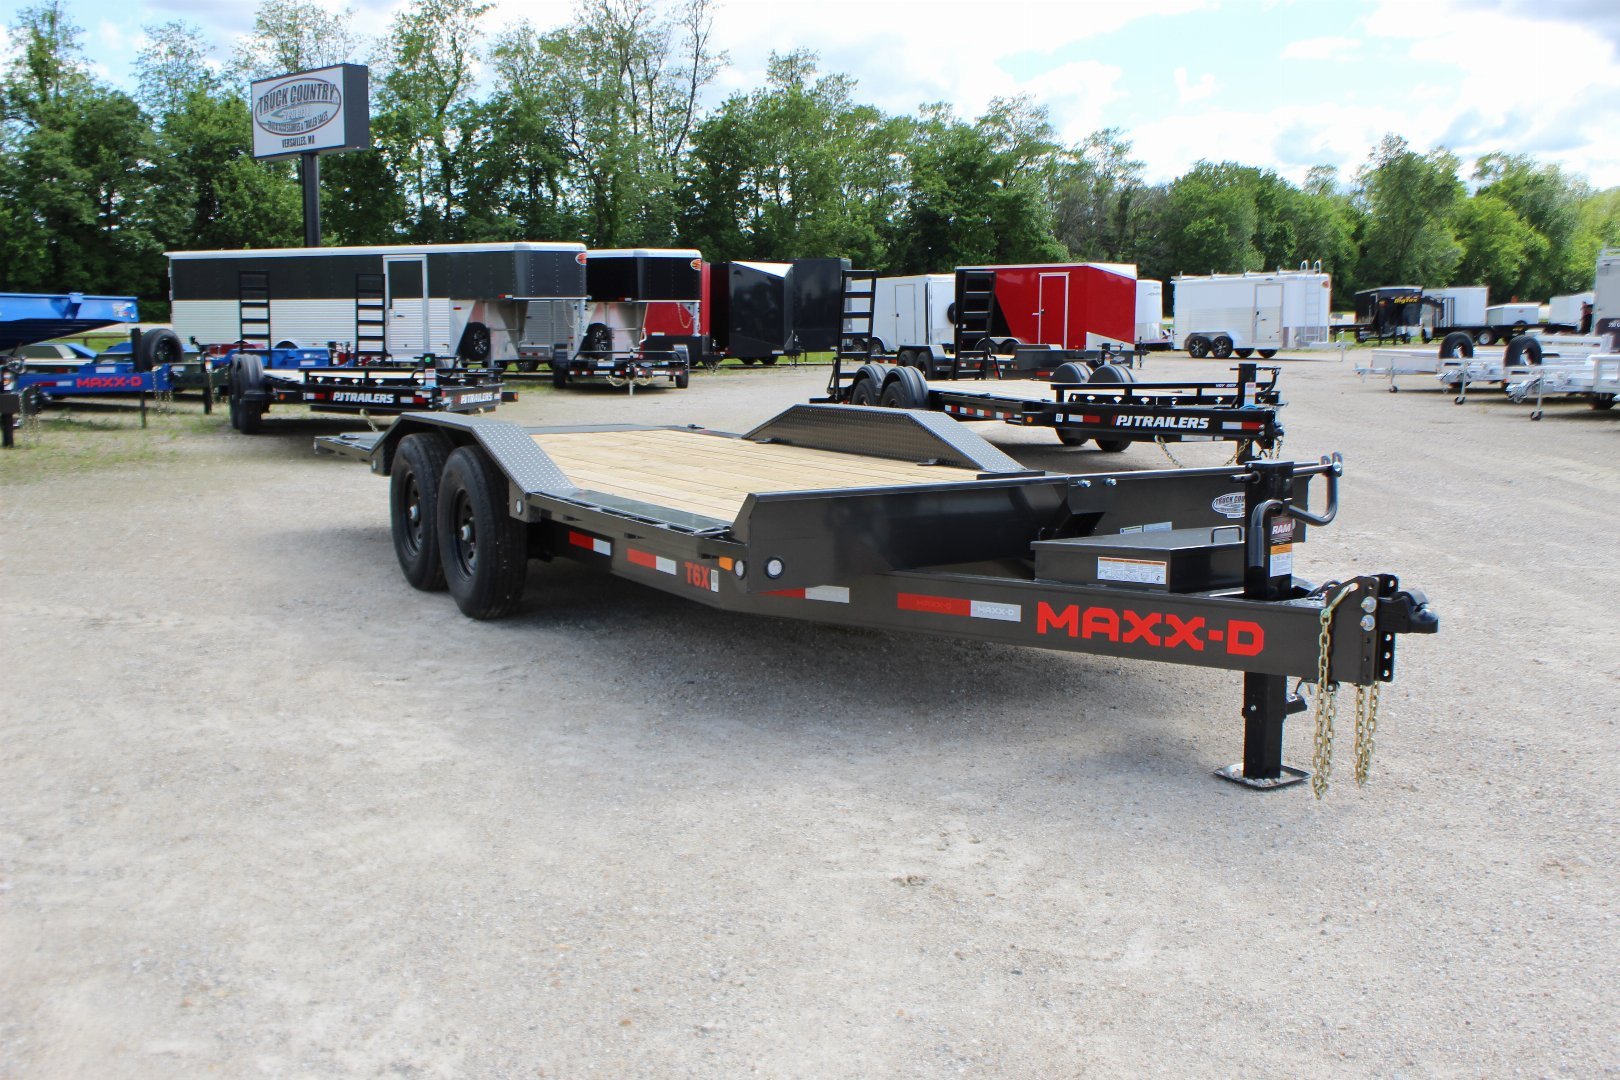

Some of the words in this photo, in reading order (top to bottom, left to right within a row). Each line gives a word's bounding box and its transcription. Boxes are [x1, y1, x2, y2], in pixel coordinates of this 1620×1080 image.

[258, 88, 288, 115] TRUCK
[290, 84, 335, 102] COUNTRY
[76, 376, 143, 388] MAXX-D
[1272, 523, 1291, 535] RAM
[684, 561, 710, 591] T6X
[976, 605, 1015, 616] MAXX-D
[1037, 602, 1264, 657] MAXX-D
